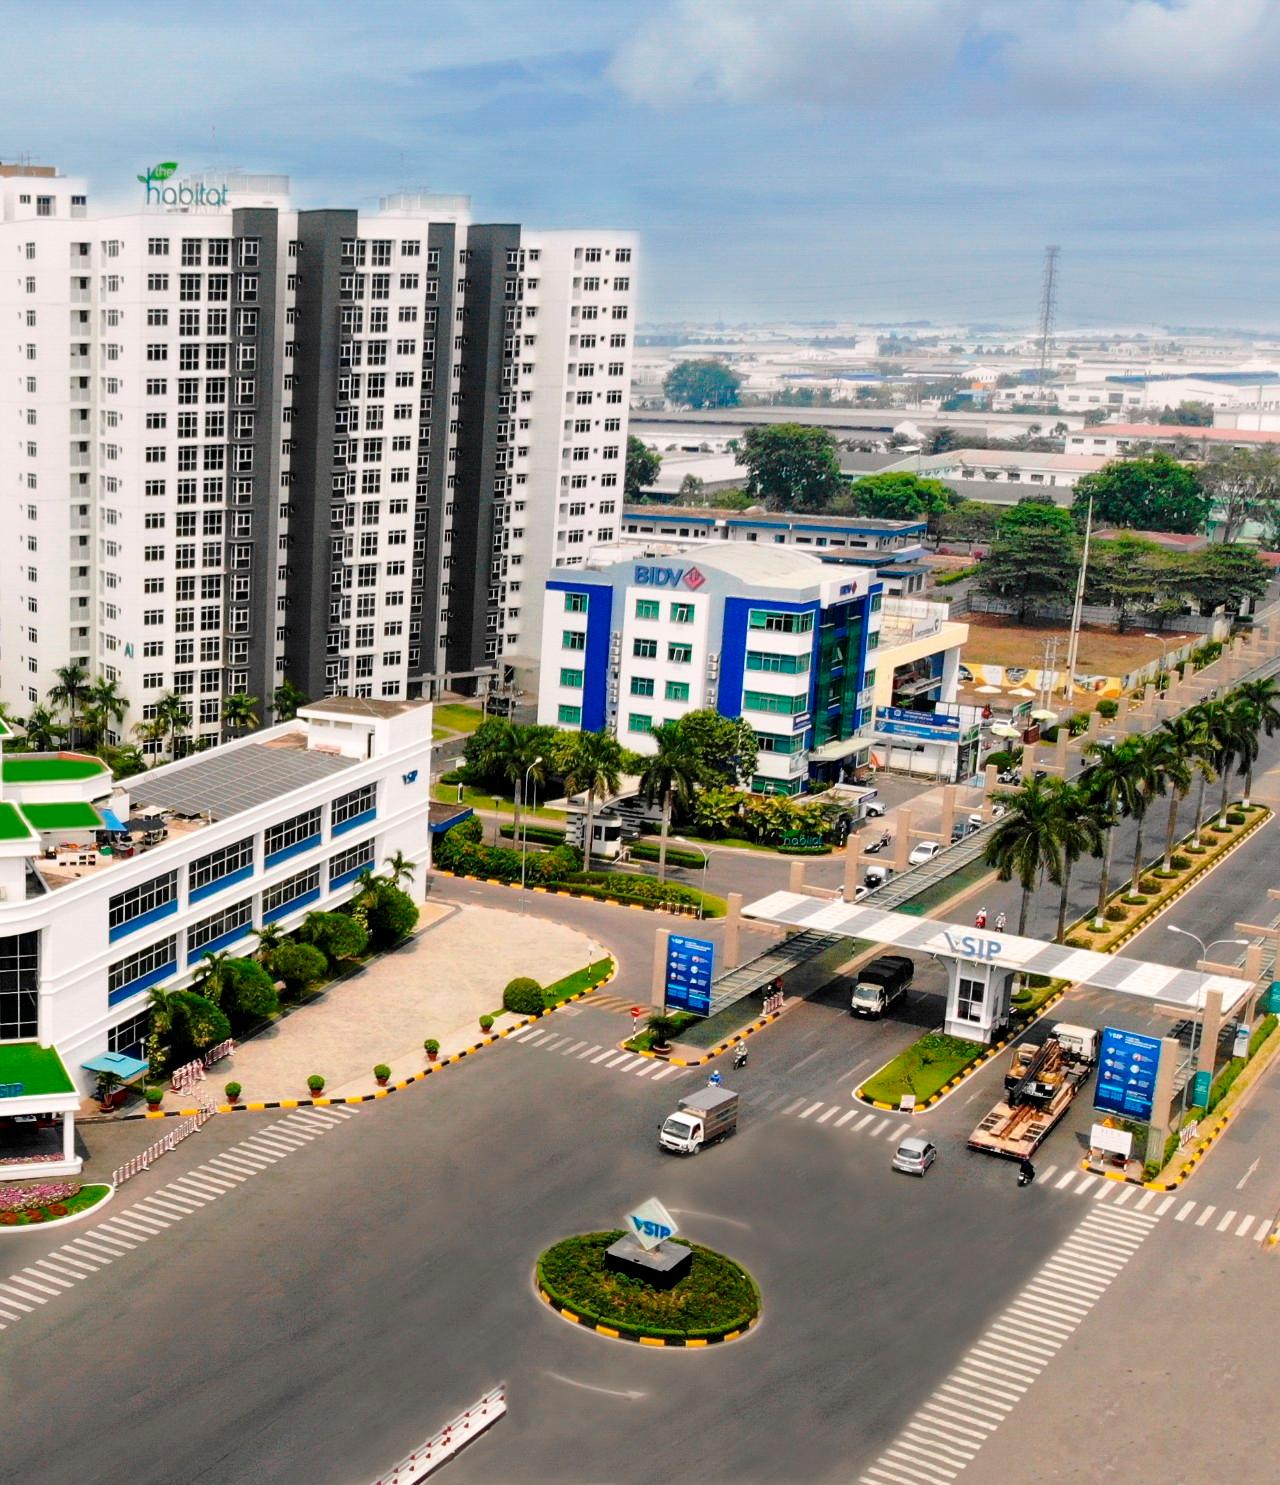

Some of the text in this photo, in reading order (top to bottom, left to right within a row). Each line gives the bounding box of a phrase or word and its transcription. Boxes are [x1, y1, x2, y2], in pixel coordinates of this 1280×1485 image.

[155, 166, 173, 177] the
[146, 168, 228, 207] habitat
[634, 565, 684, 588] BIDV
[944, 931, 1002, 960] VSIP
[630, 1215, 671, 1239] VSIP
